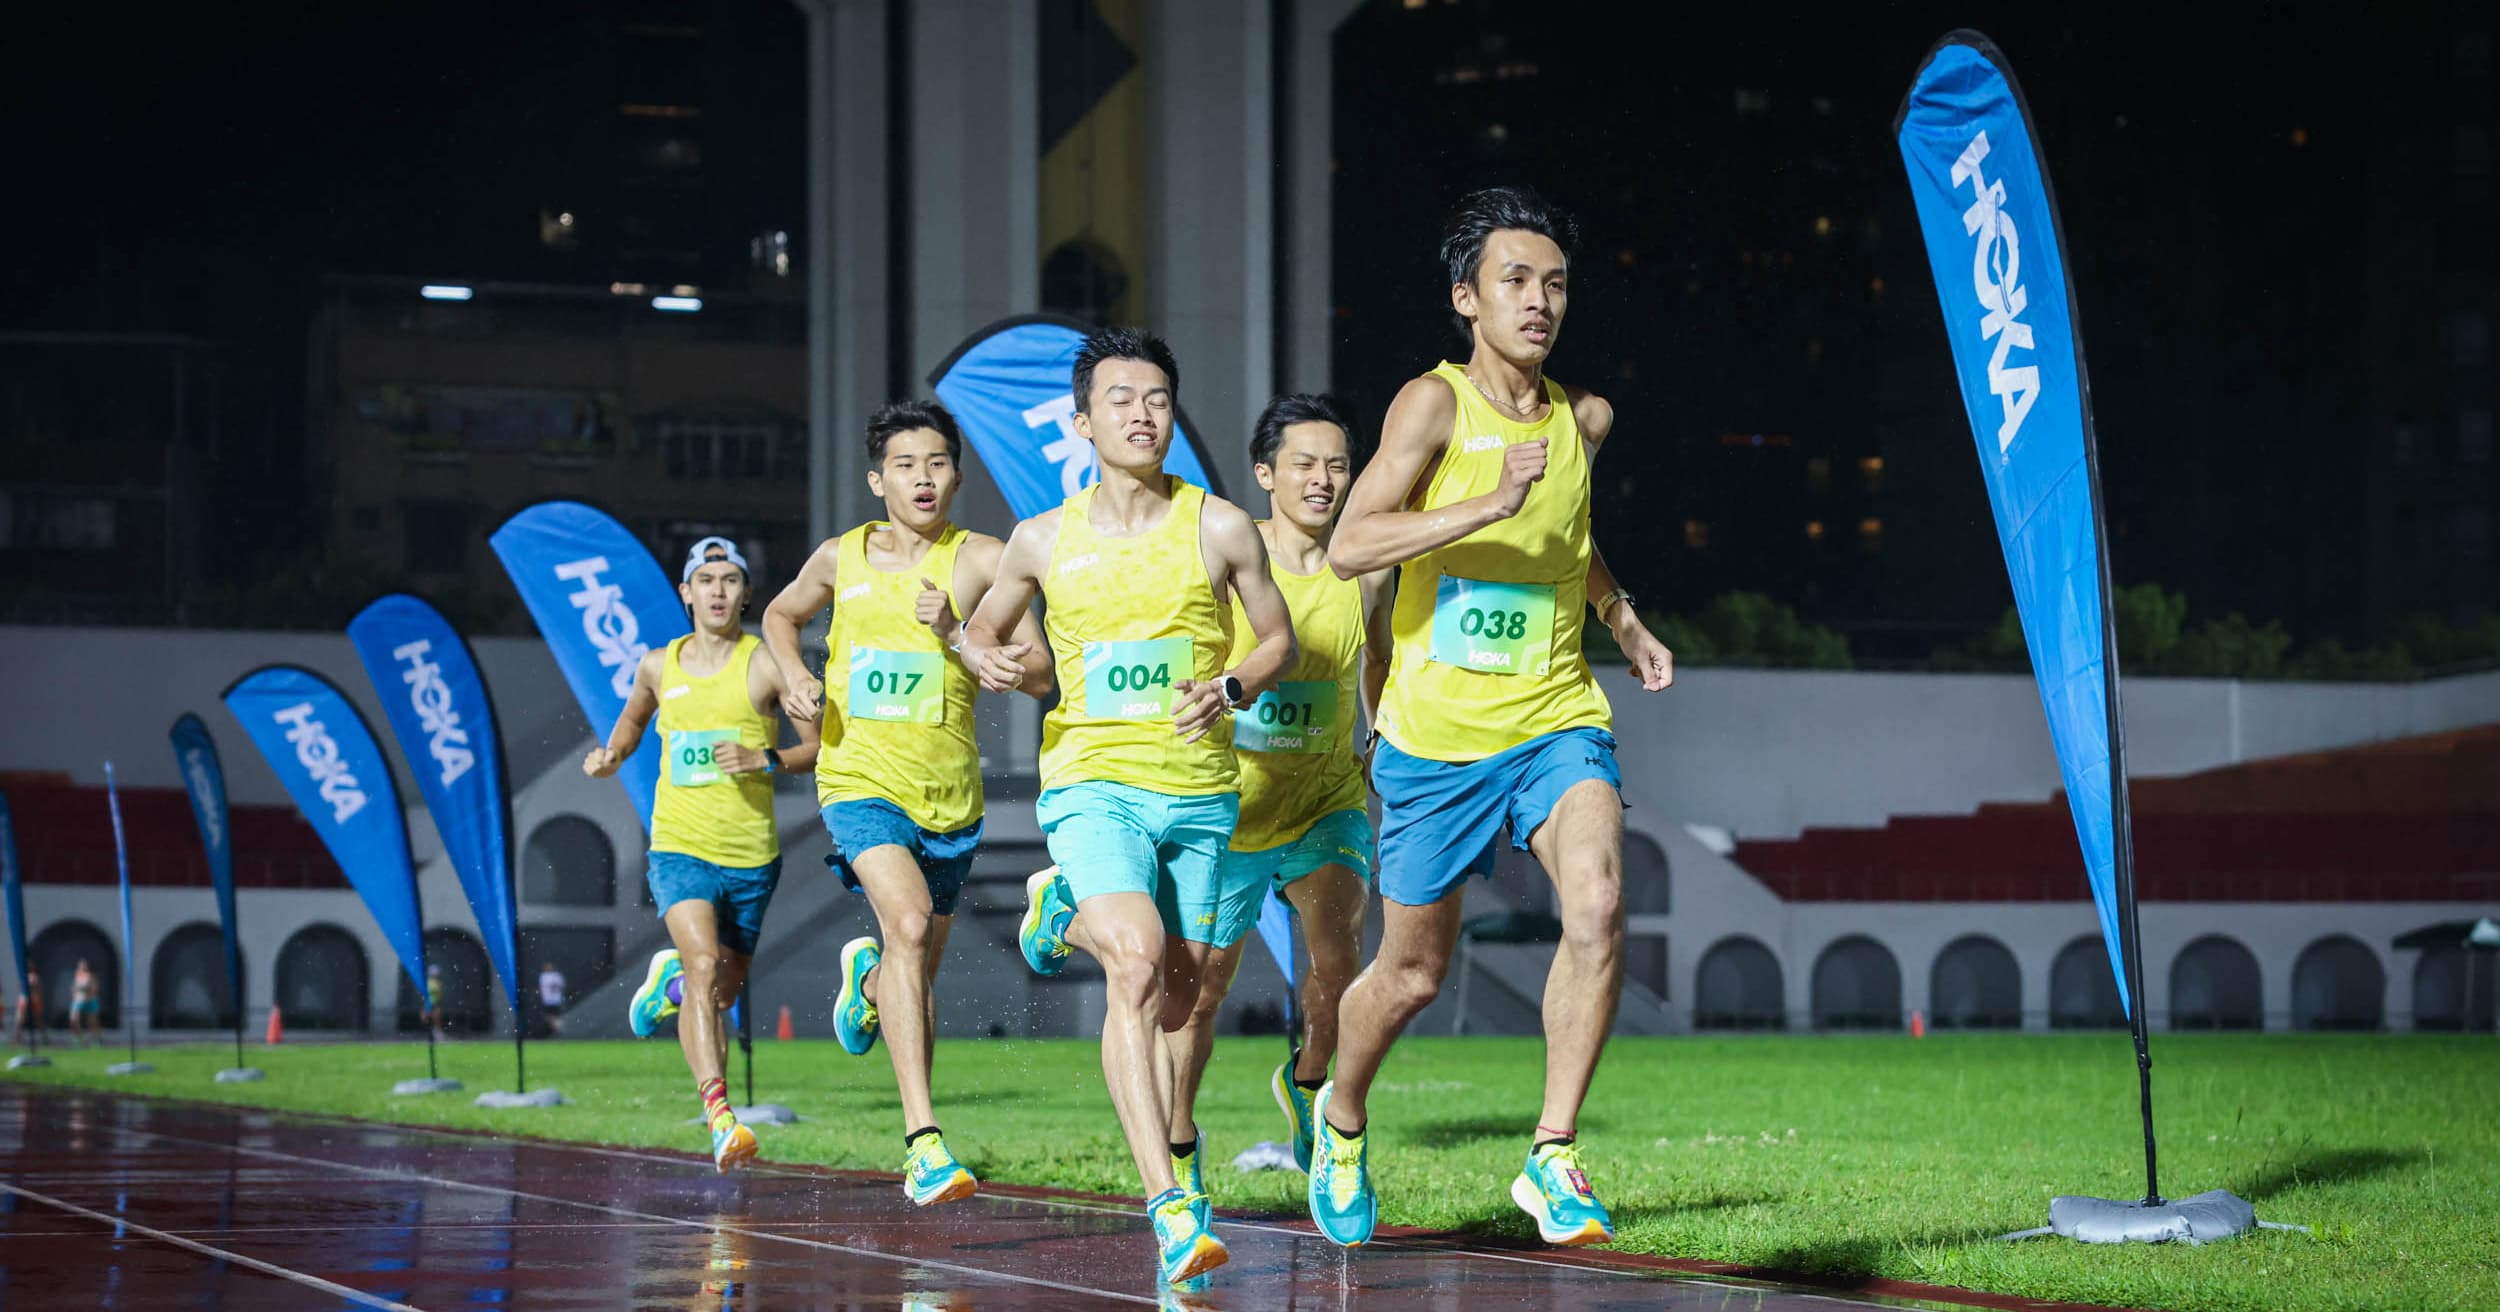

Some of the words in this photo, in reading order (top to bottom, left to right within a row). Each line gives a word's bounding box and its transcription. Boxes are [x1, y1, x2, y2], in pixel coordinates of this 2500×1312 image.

[1951, 129, 2041, 453] HOKA
[1463, 433, 1505, 455] HOKA
[1060, 553, 1099, 576] HOKA
[554, 555, 650, 699] HOK
[1460, 607, 1527, 640] 038
[1467, 649, 1511, 667] HOKA
[867, 670, 924, 695] 017
[1107, 663, 1171, 692] 004
[392, 638, 475, 790] HOKA
[875, 704, 910, 717] HOKA
[1121, 701, 1162, 717] HOKA
[1258, 702, 1312, 726] 001
[1266, 735, 1303, 748] HOKA
[274, 702, 367, 824] HOKA
[683, 747, 717, 766] 03
